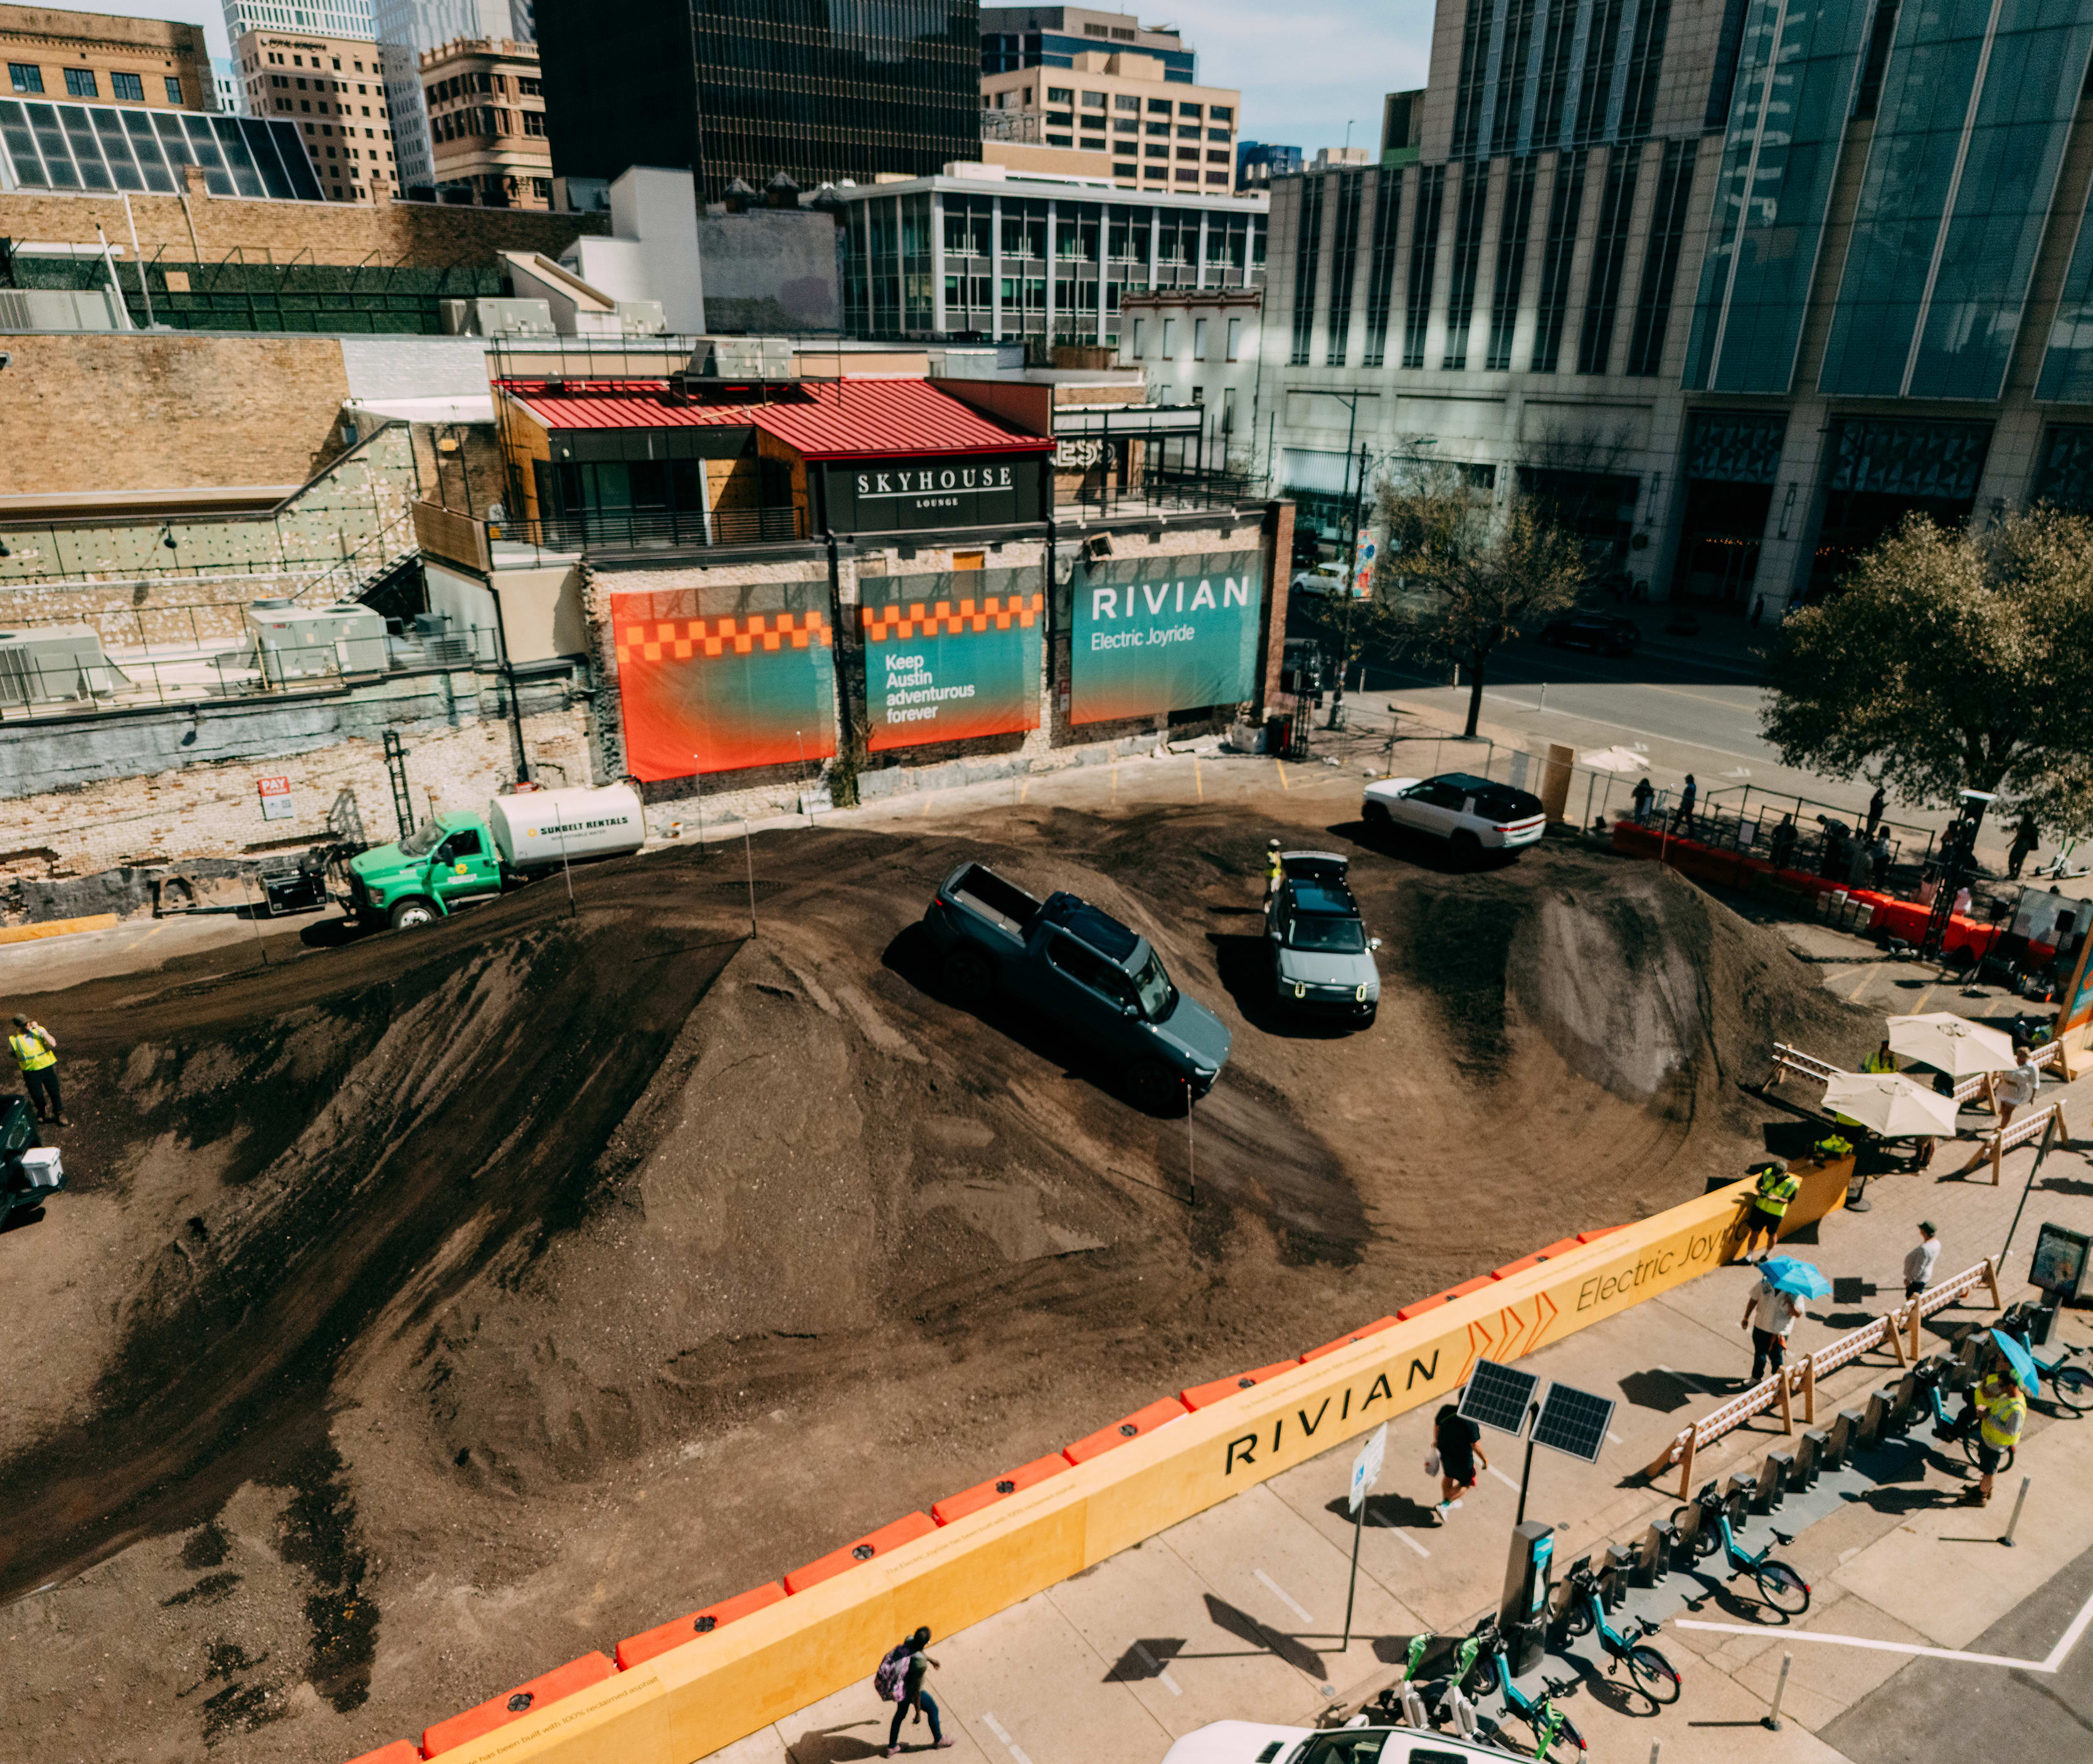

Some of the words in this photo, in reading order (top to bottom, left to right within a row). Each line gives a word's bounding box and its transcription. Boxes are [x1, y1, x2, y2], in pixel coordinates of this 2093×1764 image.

[857, 467, 1012, 493] SKYHOUSE
[916, 497, 959, 508] LOUNGE
[1092, 576, 1249, 620] RIVIAN
[1091, 628, 1144, 651] Electric
[1145, 624, 1195, 647] Joyride
[886, 654, 925, 672] Keep
[886, 670, 933, 689] Austin
[886, 684, 976, 706] adventurous
[886, 706, 939, 724] forever
[262, 778, 285, 790] PAY
[541, 822, 583, 835] SUNBELT
[586, 816, 628, 828] RENTALS
[1576, 1250, 1674, 1312] Electric
[1225, 1348, 1440, 1476] RIVIAN
[479, 1748, 496, 1763] has
[497, 1740, 521, 1755] been
[521, 1727, 541, 1743] built
[542, 1719, 561, 1734] with
[562, 1710, 586, 1724] 100%
[586, 1689, 628, 1714] reclaimed
[629, 1676, 659, 1695] asphalt
